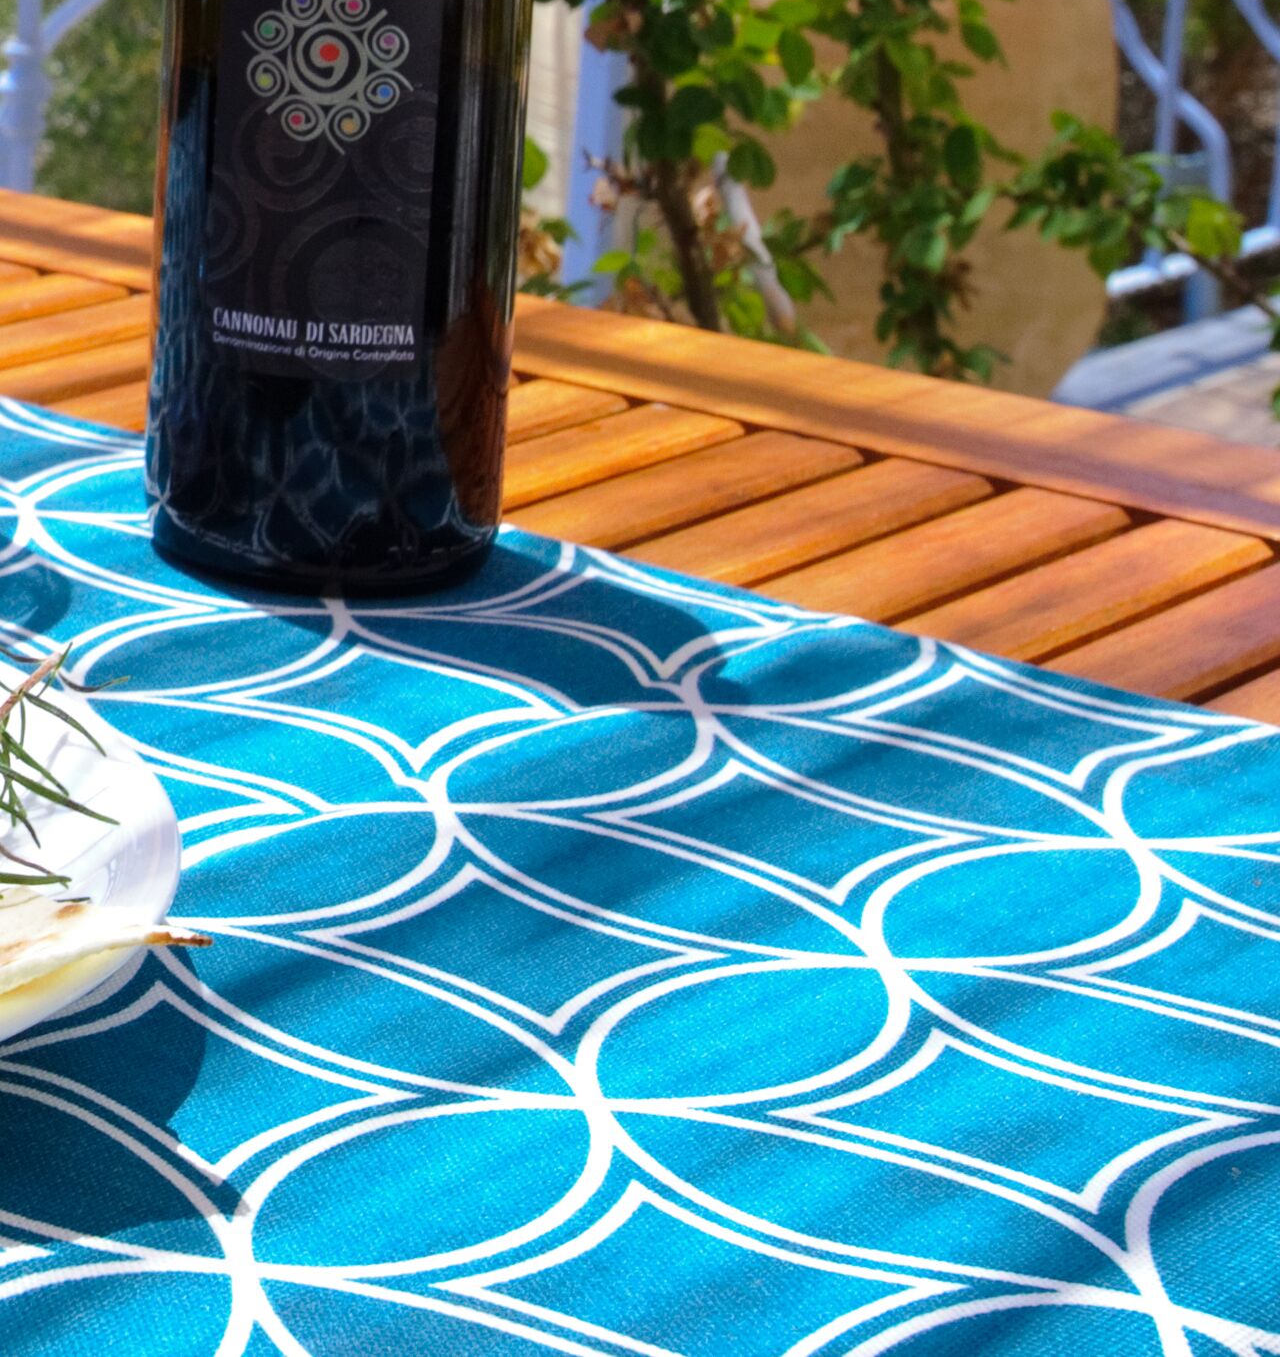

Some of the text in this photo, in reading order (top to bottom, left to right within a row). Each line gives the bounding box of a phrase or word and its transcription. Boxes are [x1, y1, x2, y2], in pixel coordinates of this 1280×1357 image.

[212, 306, 415, 345] CANNONAU DI SARDEGNA
[294, 345, 306, 358] di
[308, 345, 350, 362] Origine
